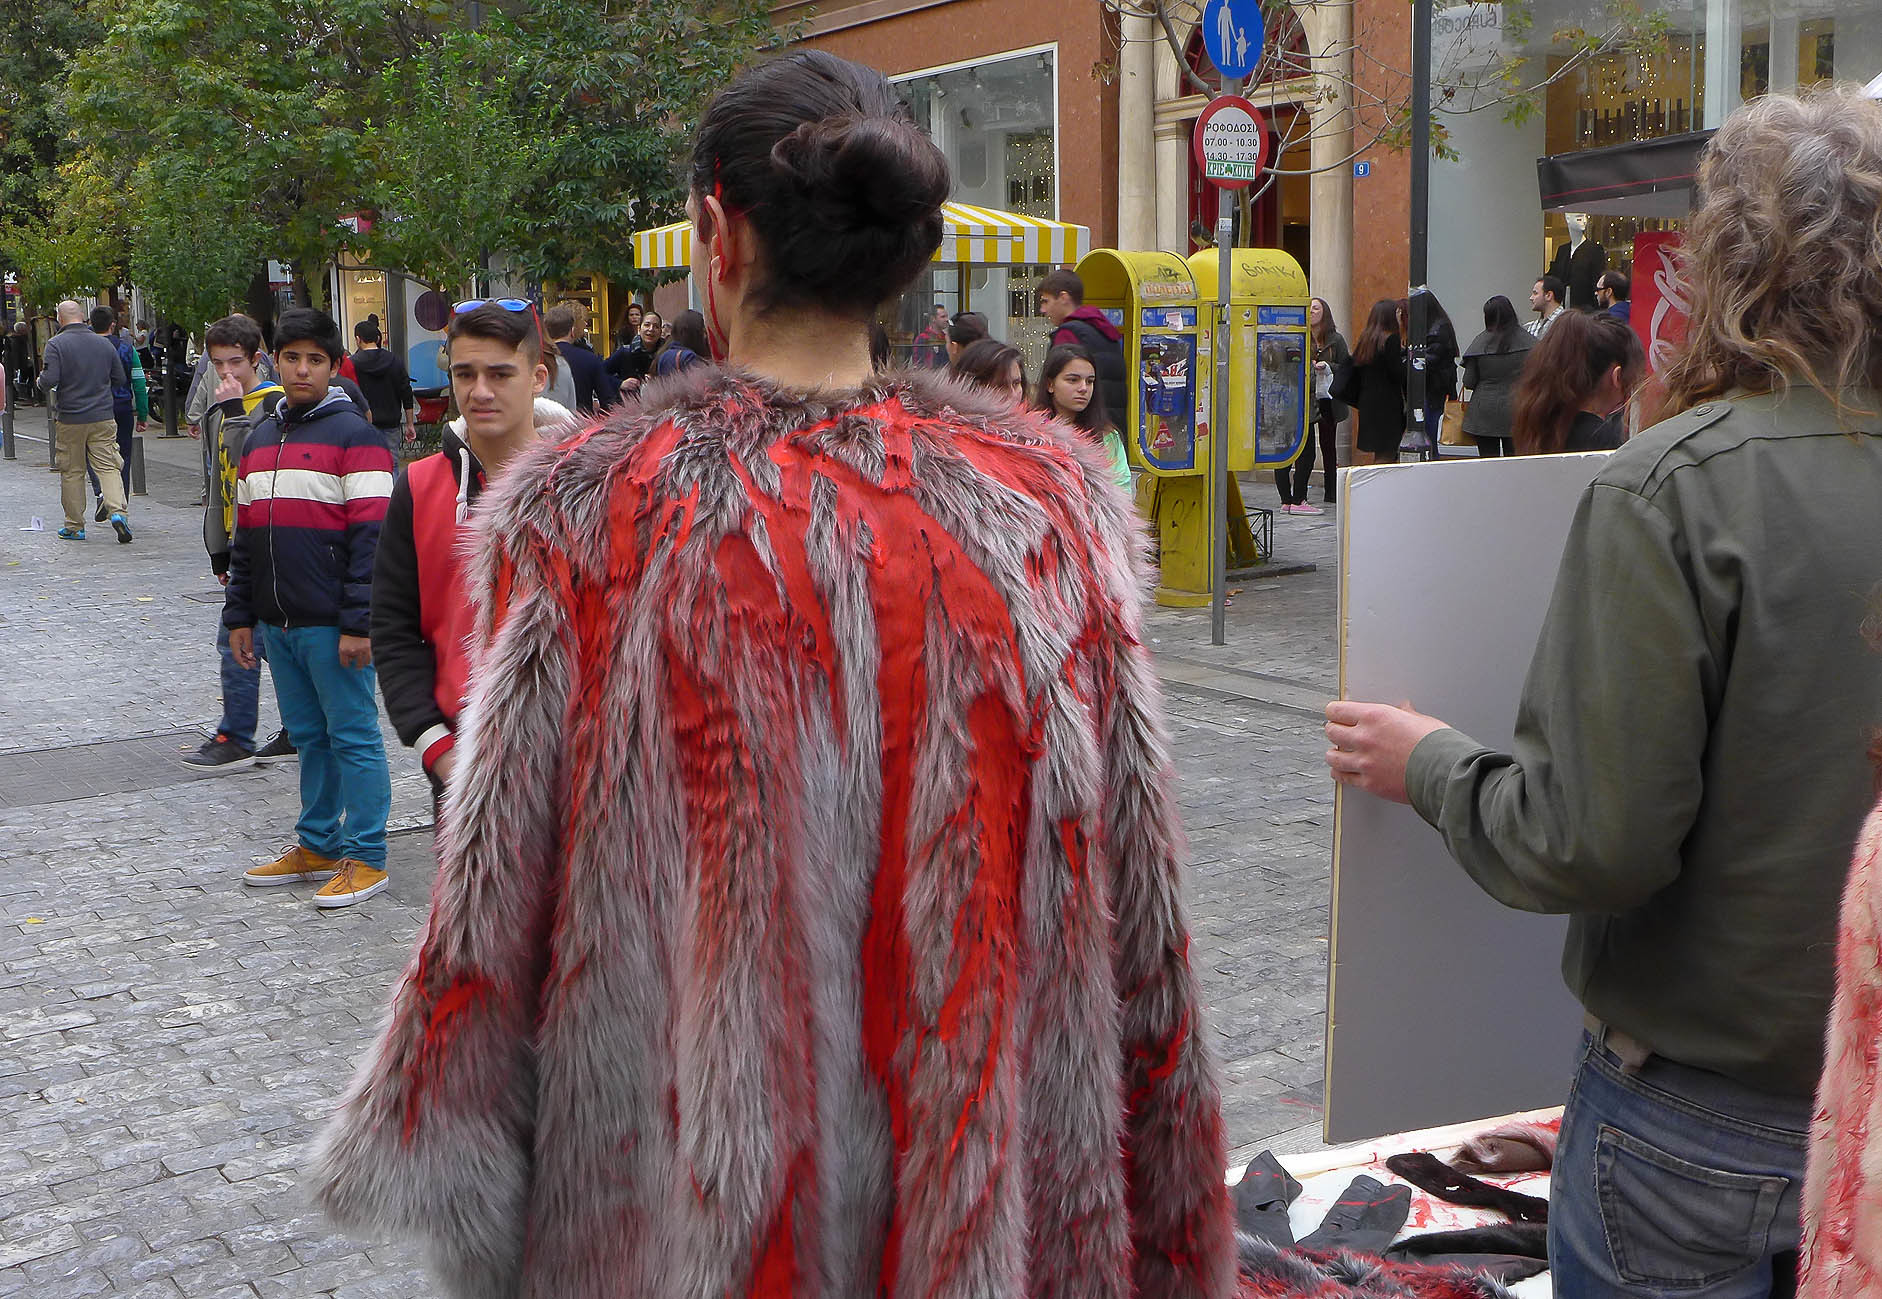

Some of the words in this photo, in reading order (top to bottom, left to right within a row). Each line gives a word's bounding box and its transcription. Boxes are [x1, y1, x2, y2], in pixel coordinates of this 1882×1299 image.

[1205, 138, 1227, 146] 07.00
[1236, 138, 1257, 146] 10.30
[1206, 152, 1227, 160] 14.30
[1236, 152, 1257, 160] 17.30
[1358, 164, 1364, 175] 9
